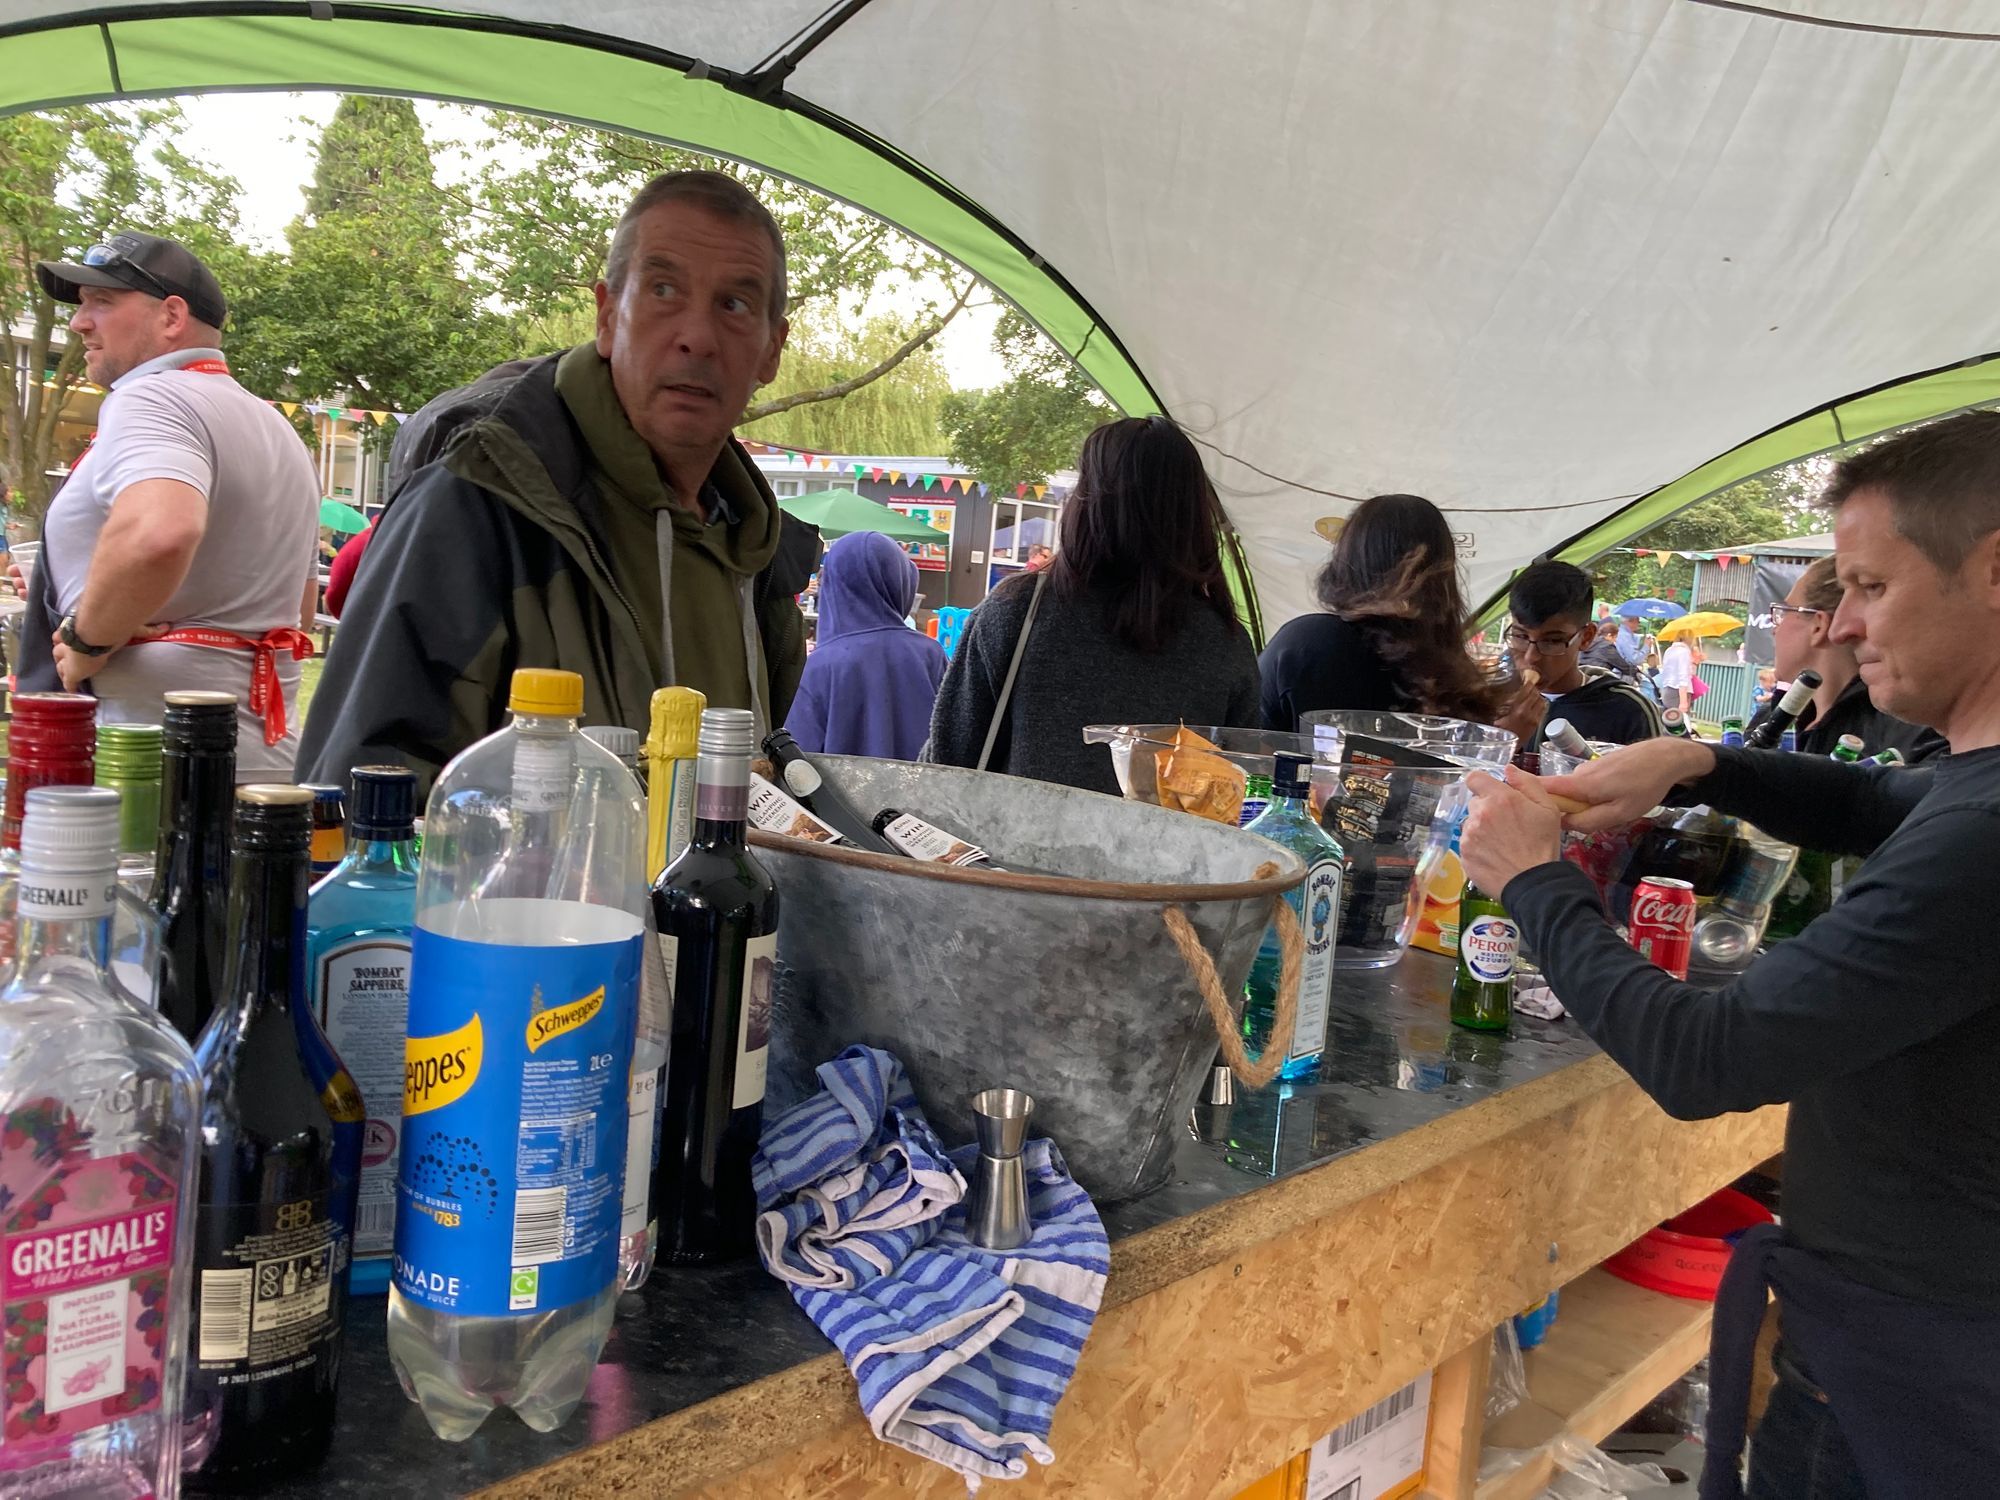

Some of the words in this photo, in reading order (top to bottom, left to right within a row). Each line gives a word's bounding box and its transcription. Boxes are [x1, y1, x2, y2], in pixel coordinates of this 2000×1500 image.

[748, 789, 774, 812] WIN
[755, 796, 784, 823] GLAMPING
[760, 801, 788, 826] WEEKEND
[900, 823, 925, 840] WIN
[1311, 874, 1336, 892] BOMBAY
[1633, 891, 1688, 933] Coca
[353, 967, 405, 979] BOMBAY
[348, 979, 408, 992] SAPPHIRE
[533, 996, 601, 1042] Schweppes
[406, 1048, 466, 1103] eppes
[425, 1196, 463, 1212] BUBBLES
[433, 1210, 461, 1228] 1783
[395, 1253, 460, 1297] ONADE
[427, 1292, 457, 1307] JUICE
[58, 1311, 117, 1332] NATURAL
